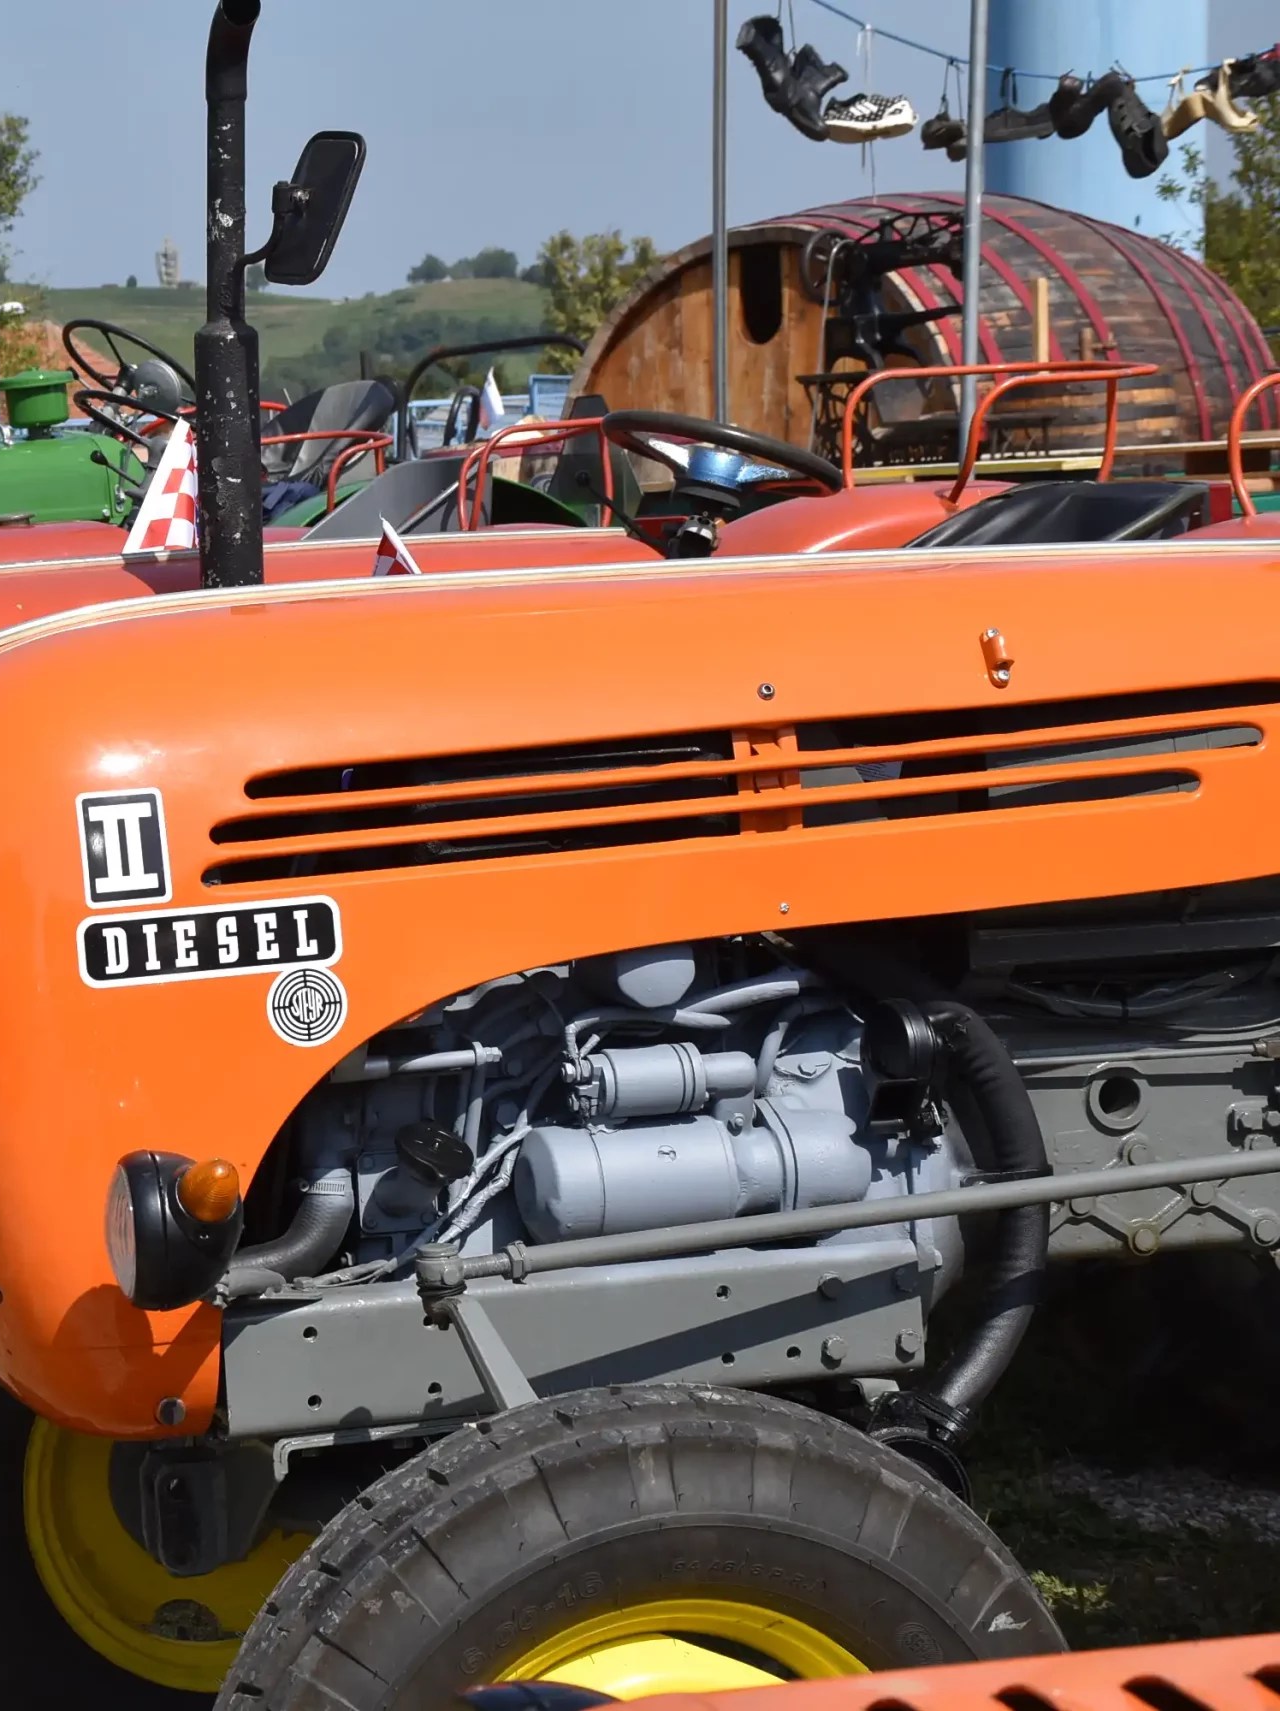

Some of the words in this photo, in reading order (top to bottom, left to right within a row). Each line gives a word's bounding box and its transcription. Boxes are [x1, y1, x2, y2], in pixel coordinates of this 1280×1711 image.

[88, 802, 160, 893] II
[102, 910, 319, 975] DIESEL
[290, 988, 324, 1023] STEYR
